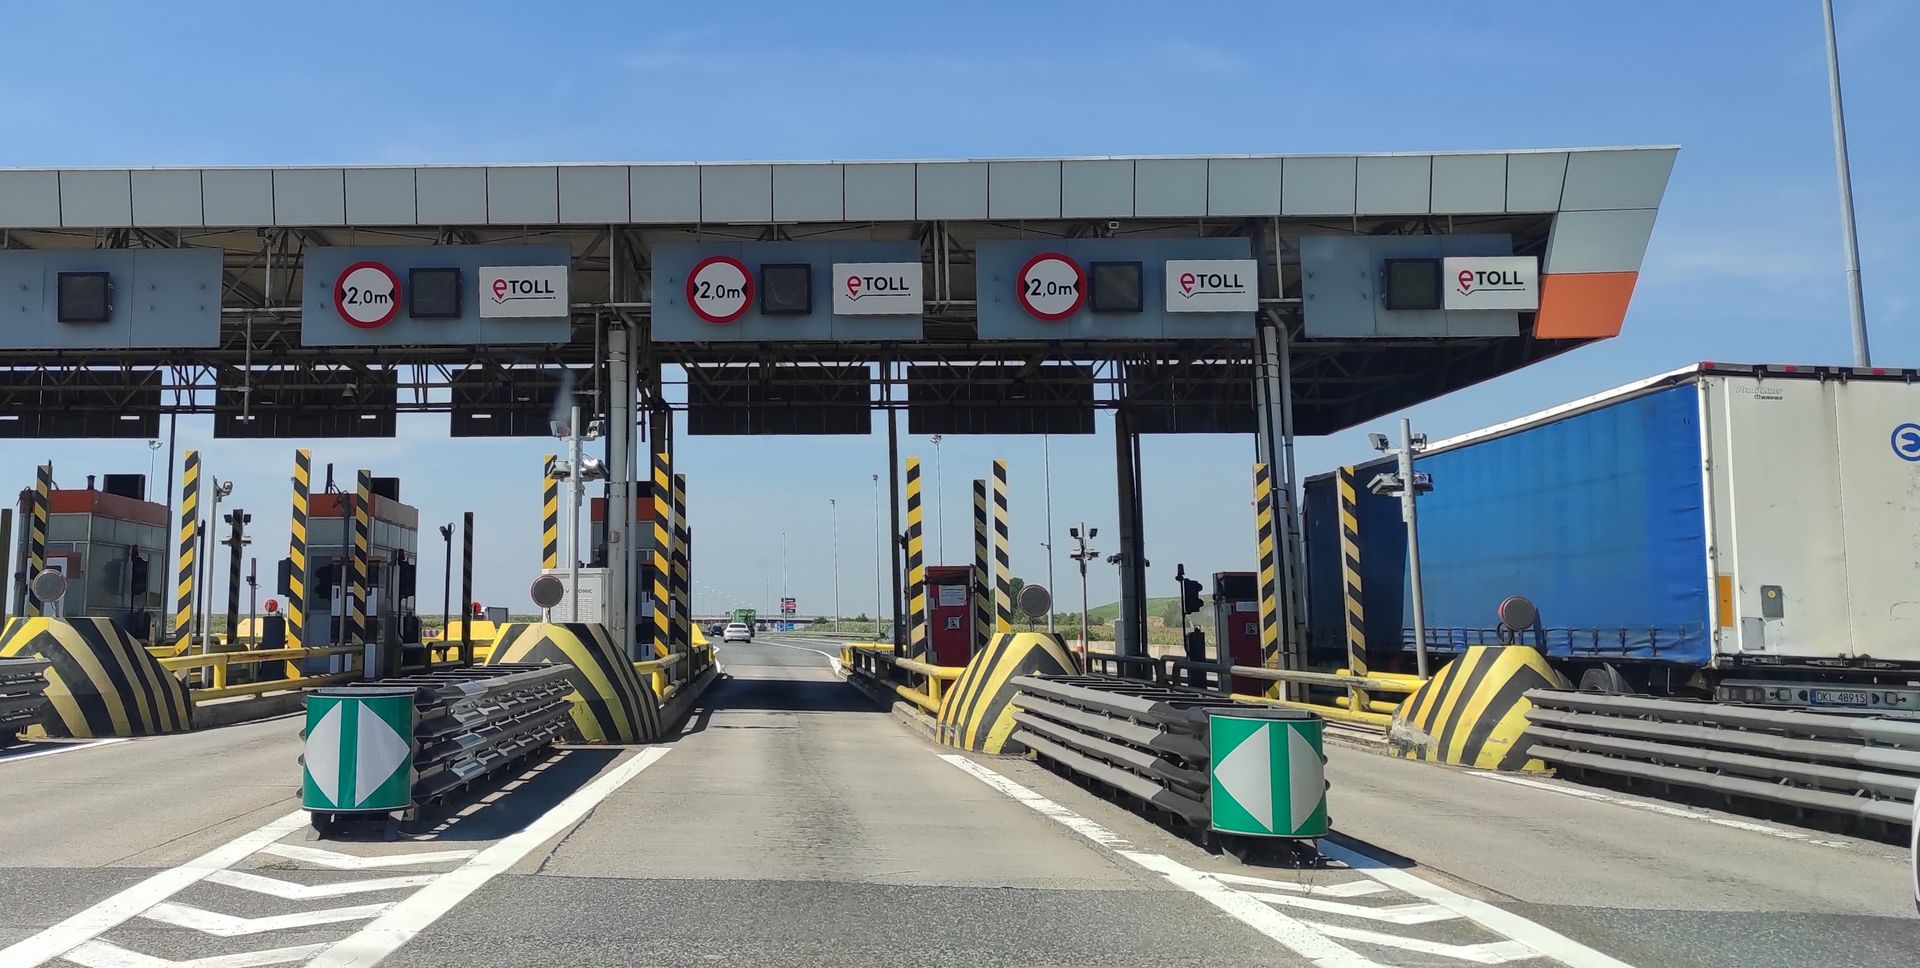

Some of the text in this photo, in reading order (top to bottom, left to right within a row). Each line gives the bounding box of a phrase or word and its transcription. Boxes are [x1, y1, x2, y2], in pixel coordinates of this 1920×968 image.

[492, 278, 555, 299] eTOLL
[847, 276, 910, 296] eTOLL
[1031, 279, 1072, 298] 2,0m
[1180, 272, 1244, 293] eTOLL
[1458, 270, 1524, 290] eTOLL
[347, 286, 388, 306] 2,0m
[700, 281, 740, 300] 2,0m
[1816, 690, 1866, 703] DKL 48915
